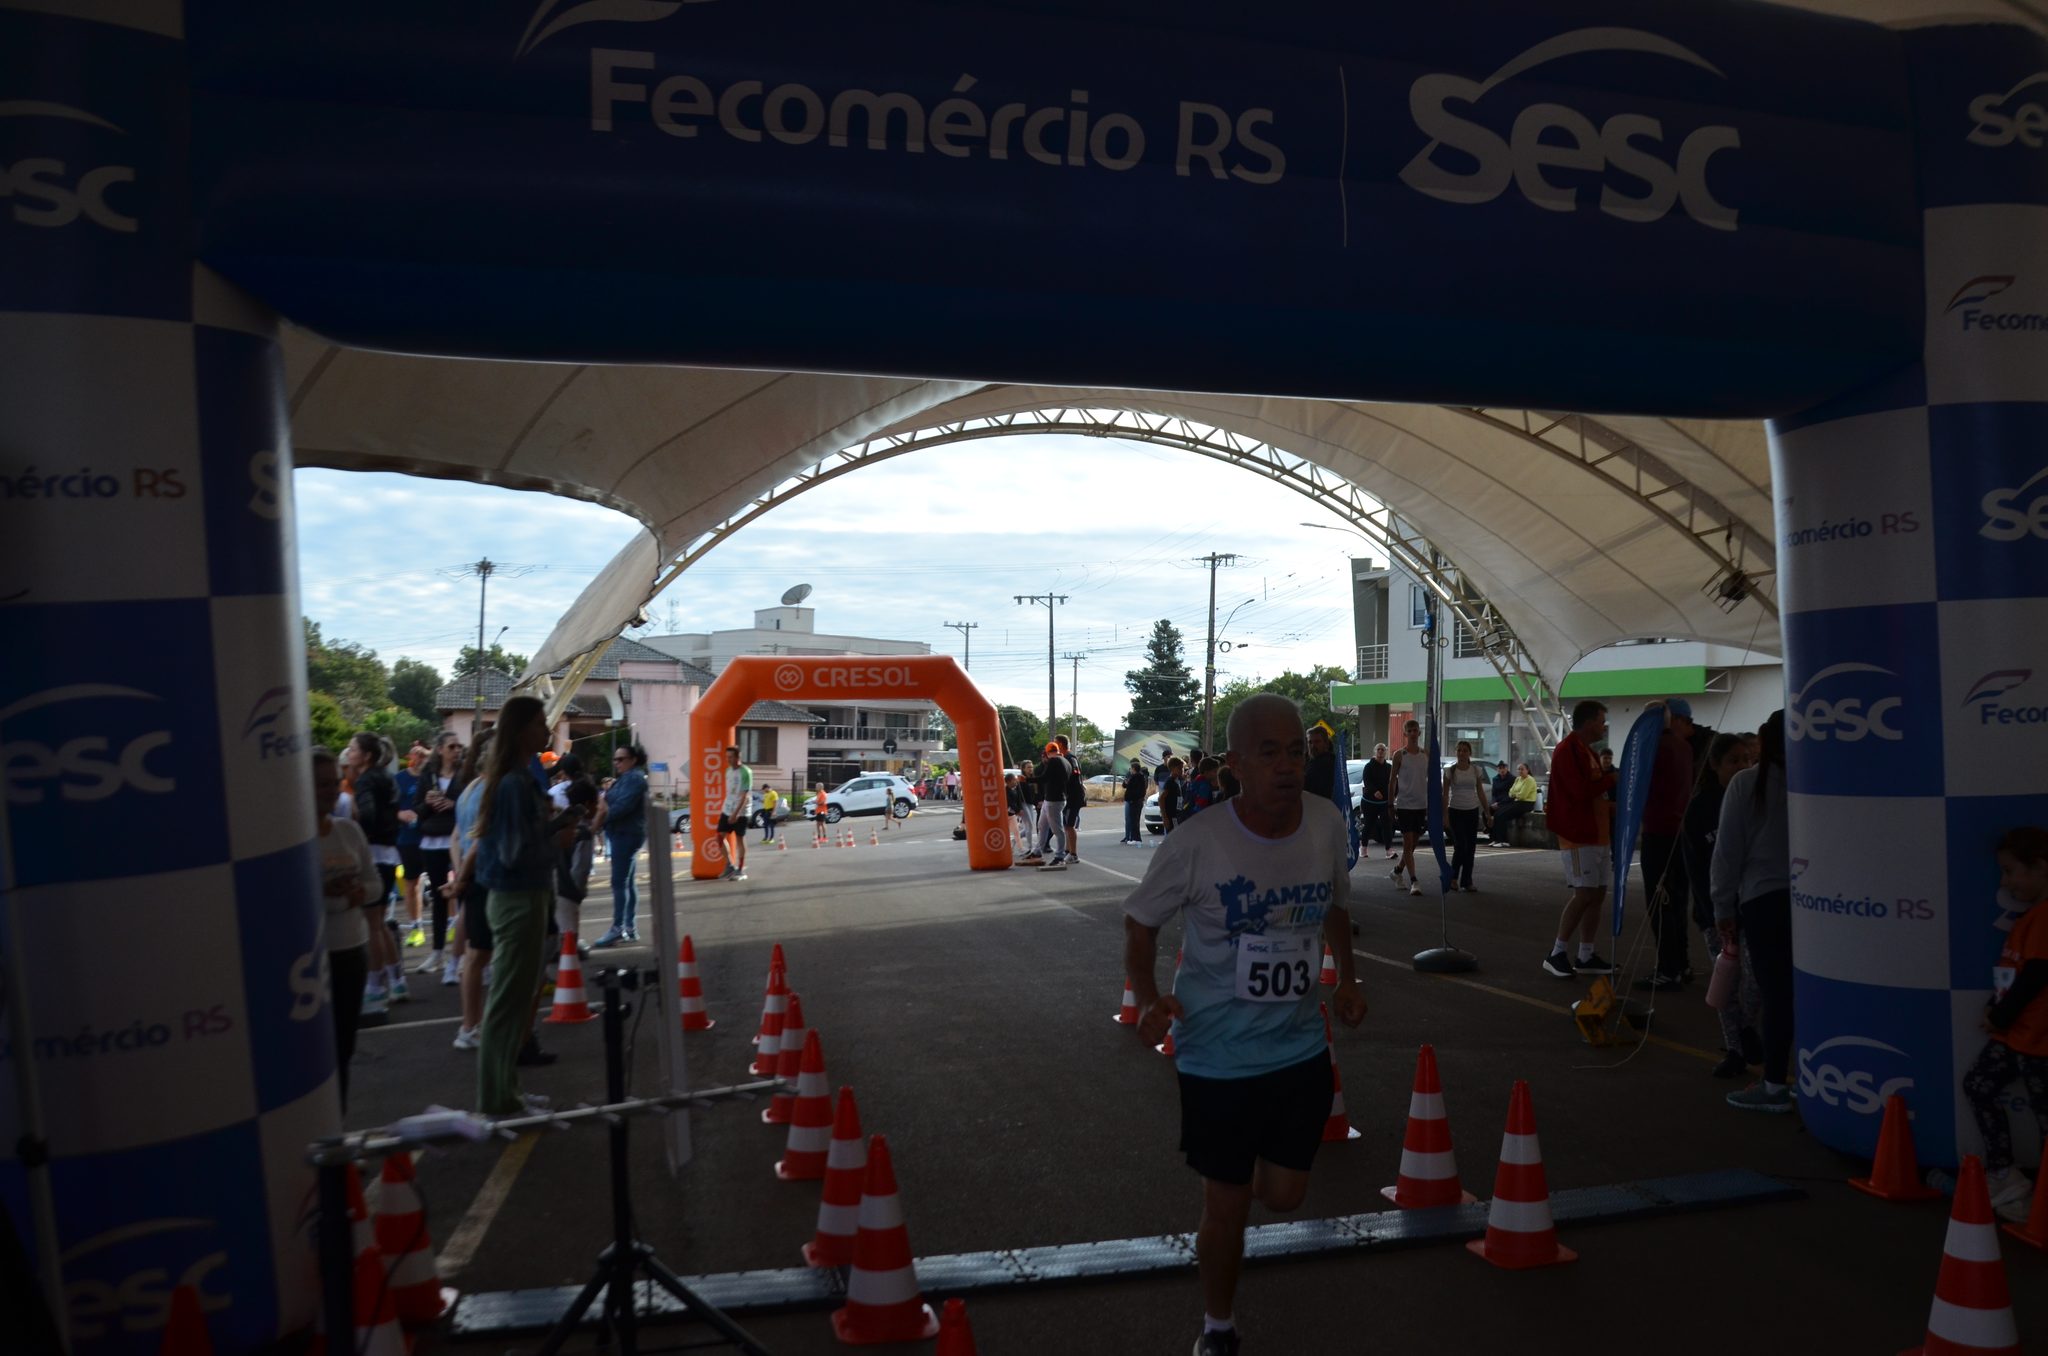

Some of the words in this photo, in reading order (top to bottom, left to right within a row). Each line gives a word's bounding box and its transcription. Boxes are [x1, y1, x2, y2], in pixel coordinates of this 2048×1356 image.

[590, 48, 1146, 171] Fecomércio
[1176, 101, 1286, 185] RS
[1398, 73, 1741, 231] Sesc
[0, 157, 139, 232] sc
[132, 468, 186, 498] RS
[1880, 511, 1920, 535] RS
[812, 667, 919, 688] CRESOL
[703, 740, 723, 831] CRESOL
[977, 734, 1001, 821] CRESOL
[1895, 898, 1935, 920] RS
[1247, 960, 1311, 997] 503
[183, 1005, 233, 1040] RS
